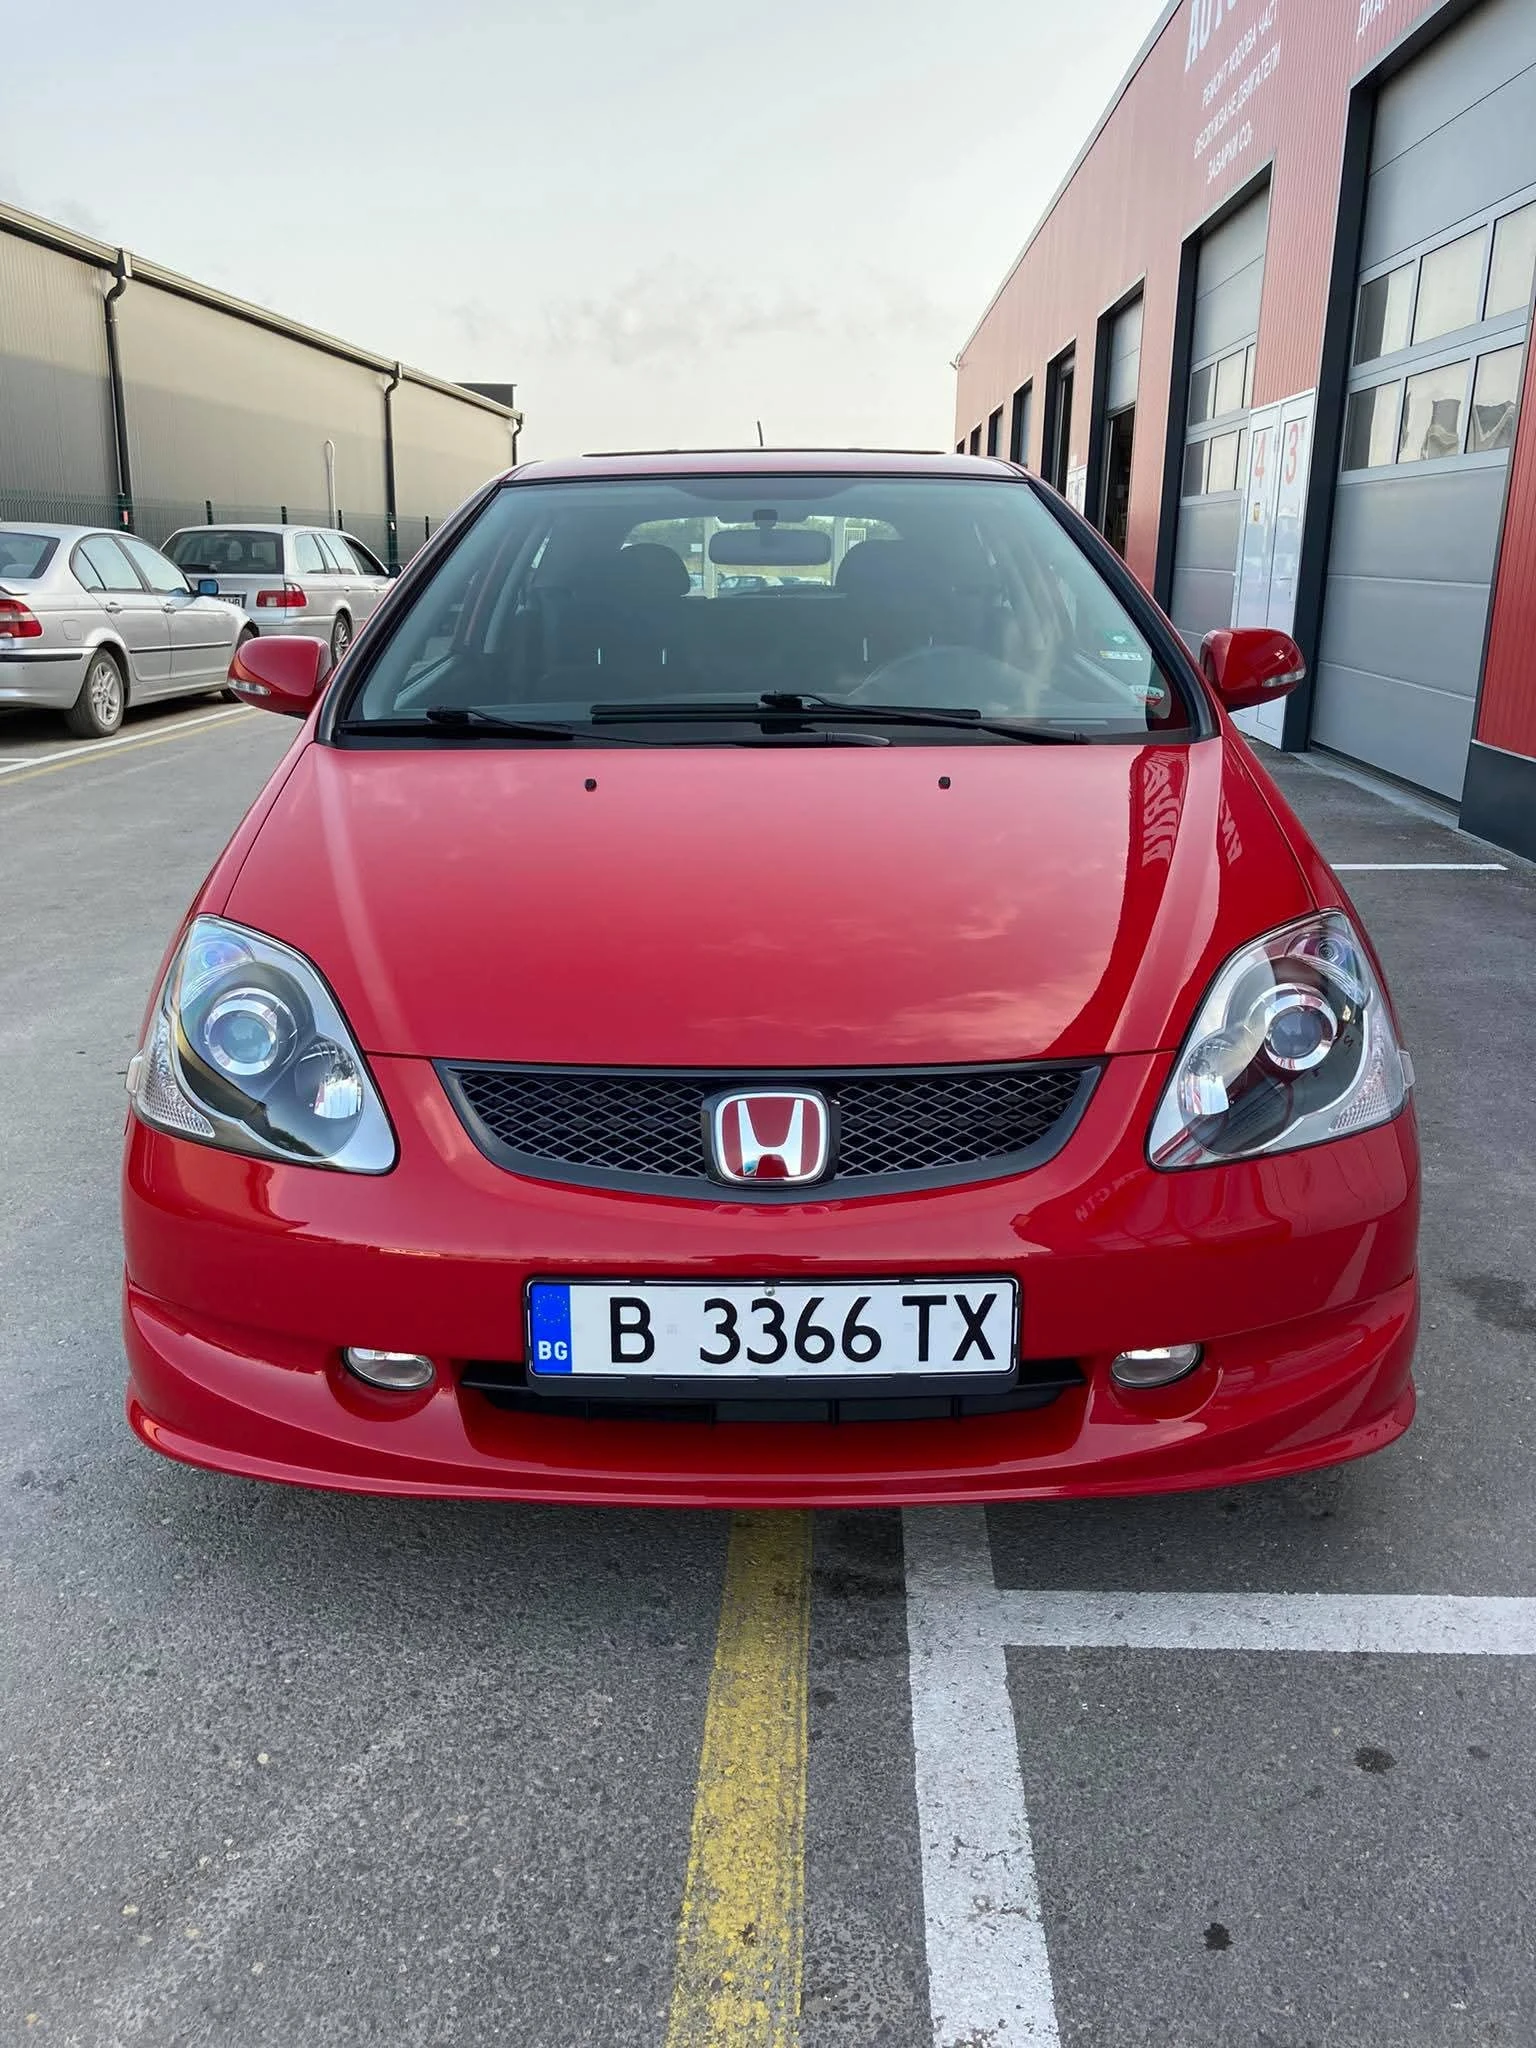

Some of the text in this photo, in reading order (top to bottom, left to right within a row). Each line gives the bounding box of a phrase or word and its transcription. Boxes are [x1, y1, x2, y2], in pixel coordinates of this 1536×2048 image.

[1285, 422, 1299, 485] 3
[538, 1341, 568, 1361] BG
[609, 1293, 998, 1364] B 3366 TX
